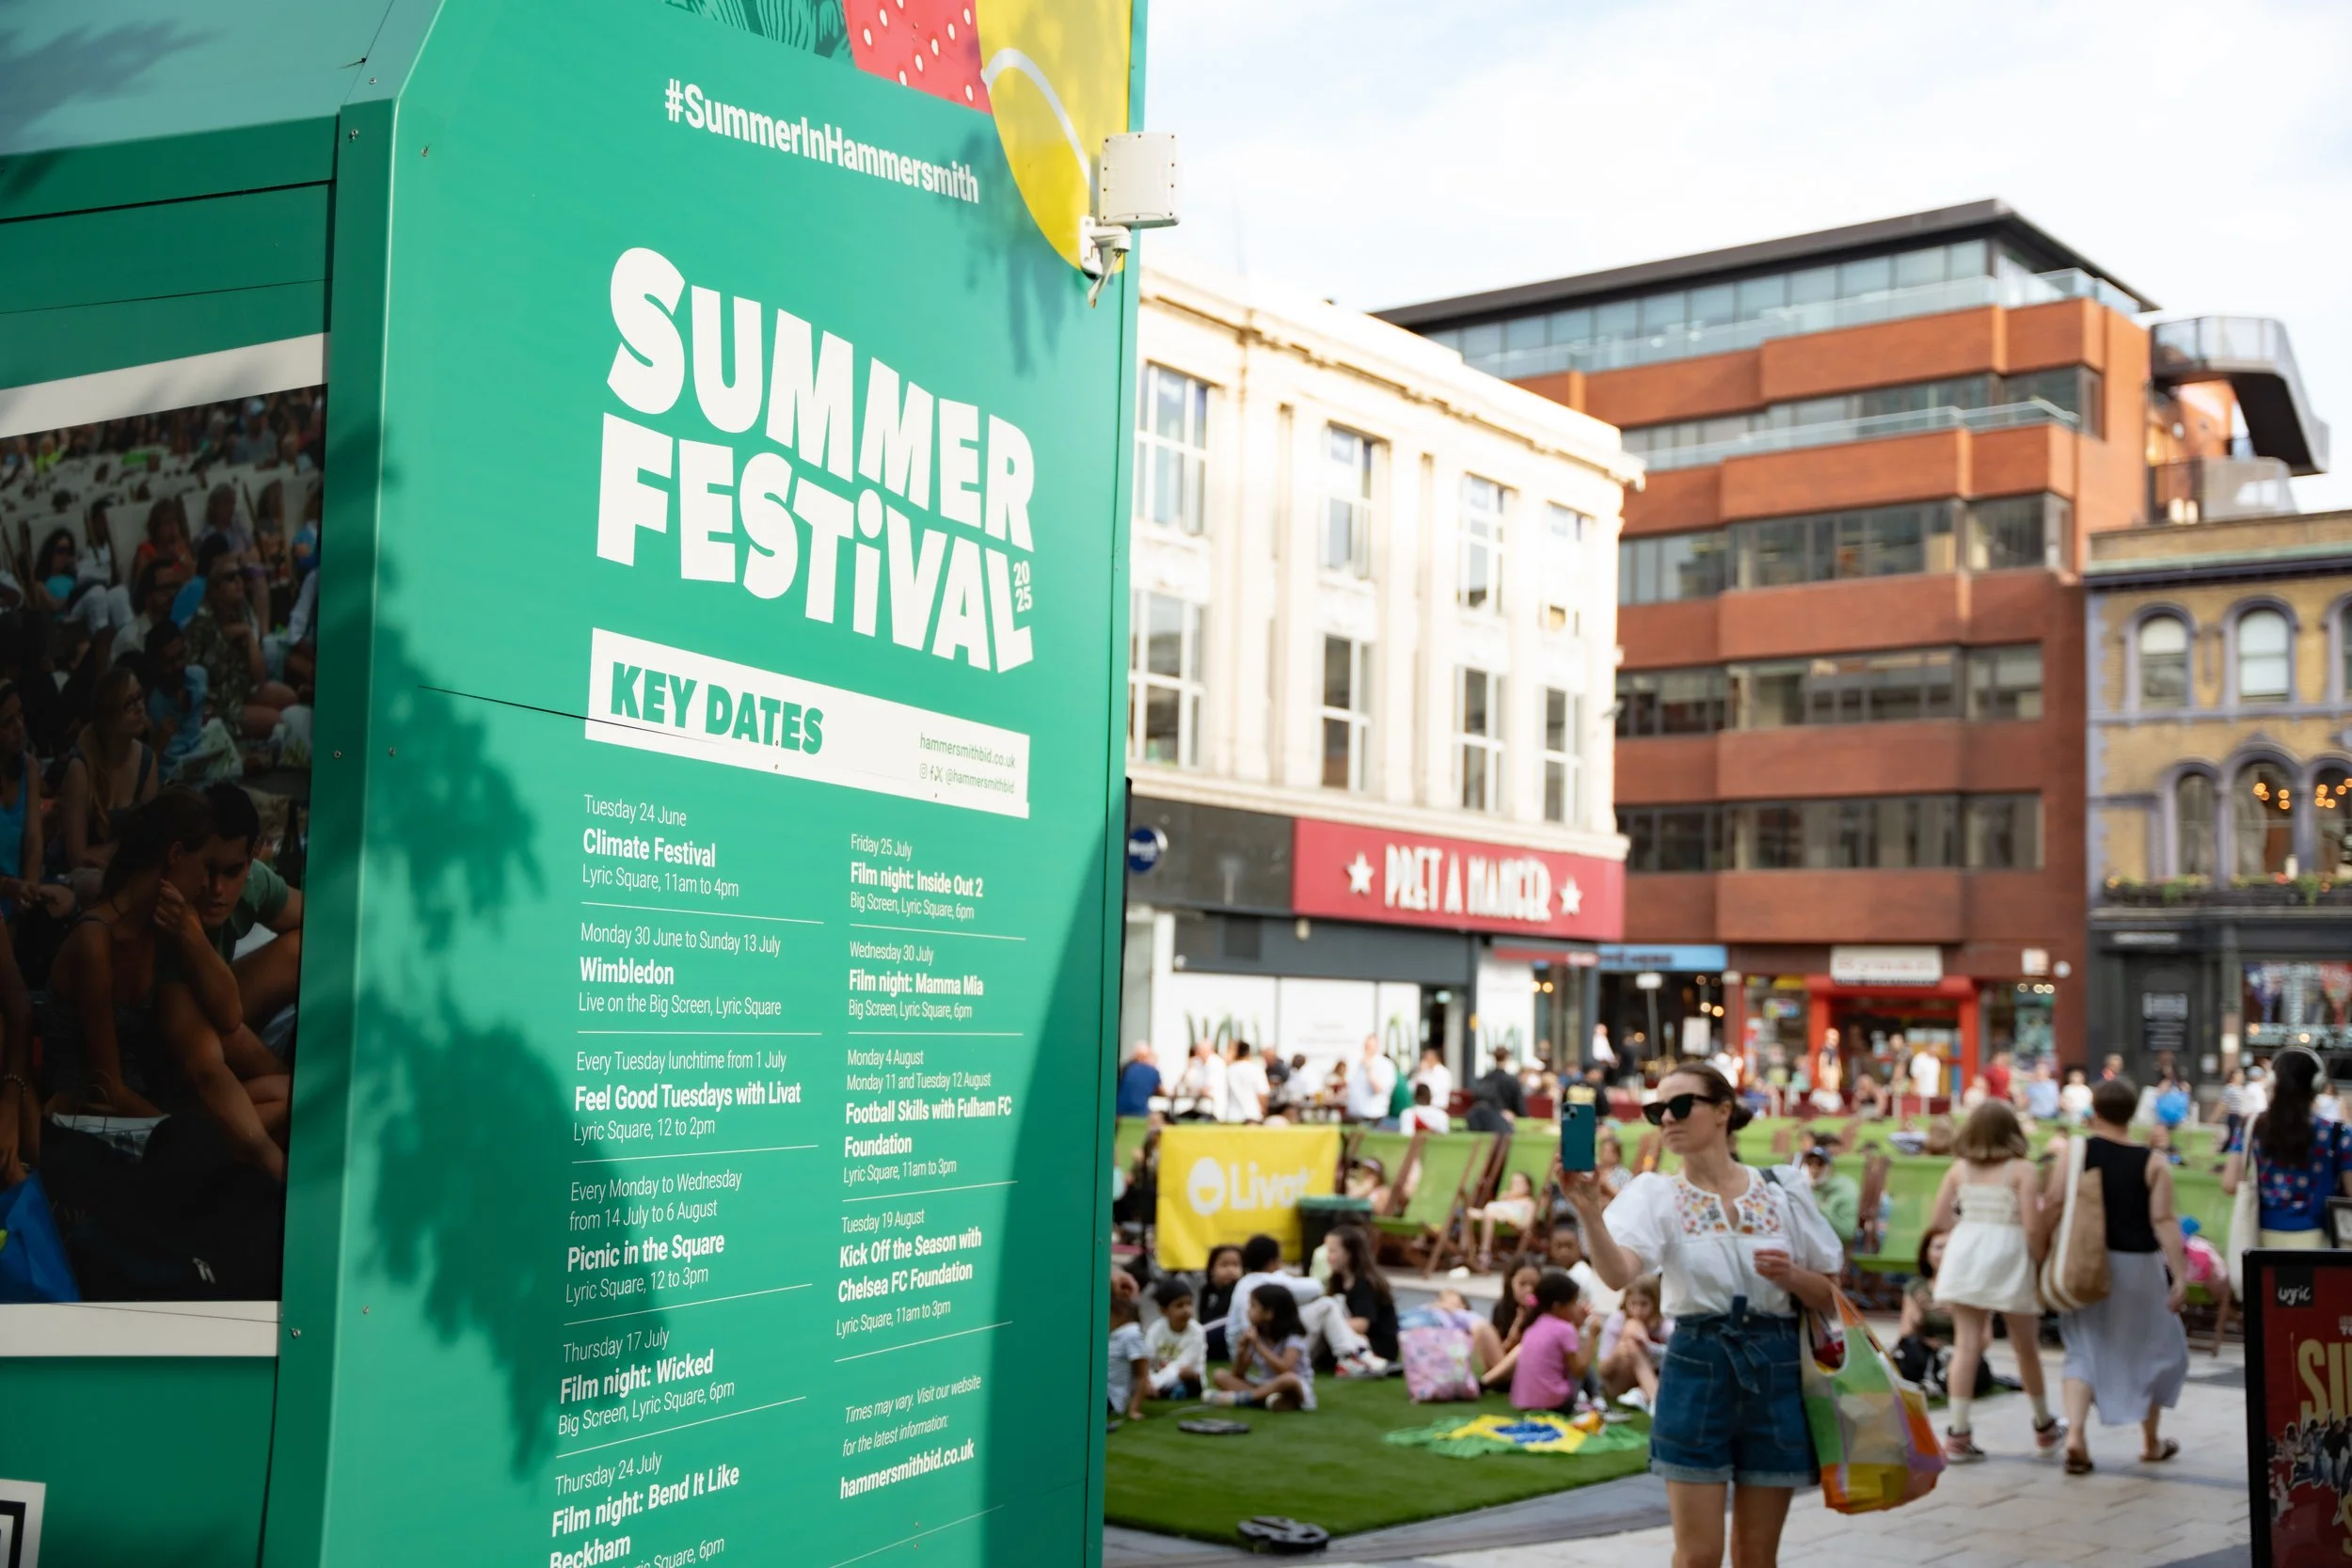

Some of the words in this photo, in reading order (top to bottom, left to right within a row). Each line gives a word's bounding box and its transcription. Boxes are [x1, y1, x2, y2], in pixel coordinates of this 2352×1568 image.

[665, 78, 979, 204] #SummerInHammersmith
[607, 246, 1034, 552] SUMMER
[611, 662, 697, 728] KEY
[706, 682, 823, 755] DATES
[919, 732, 1016, 769] hammersmithbid.co.uk
[584, 794, 637, 824] Tuesday
[640, 802, 655, 822] 24
[658, 806, 687, 827] June
[583, 828, 649, 860] Climate
[654, 836, 715, 867] Festival
[850, 833, 879, 857] Friday
[894, 841, 913, 862] July
[582, 863, 612, 888] Lyric
[615, 866, 661, 893] Square,
[665, 873, 697, 893] 11am
[714, 878, 739, 900] 4pm
[850, 862, 878, 885] Film
[881, 865, 914, 894] night:
[917, 870, 951, 894] Inside
[954, 875, 974, 896] Out
[850, 891, 866, 913] Big
[867, 893, 899, 914] Screen,
[901, 897, 922, 917] Lyric
[923, 898, 954, 920] Square,
[956, 903, 975, 922] 6pm
[581, 922, 632, 949] Monday
[635, 926, 650, 945] 30
[653, 927, 682, 947] June
[699, 930, 740, 956] Sunday
[758, 935, 781, 958] July
[850, 941, 901, 964] Wednesday
[916, 946, 933, 966] July
[580, 957, 674, 985] Wimbledon
[850, 968, 876, 991] Film
[879, 971, 913, 998] night:
[915, 973, 961, 994] Mamma
[963, 975, 983, 996] Mia
[579, 991, 605, 1012] Live
[608, 997, 624, 1012] on
[627, 992, 646, 1012] the
[650, 994, 668, 1018] Big
[672, 994, 713, 1016] Screen,
[716, 996, 741, 1019] Lyric
[744, 997, 781, 1019] Square
[849, 999, 864, 1020] Big
[866, 999, 898, 1019] Screen,
[899, 1001, 920, 1021] Lyric
[921, 1001, 952, 1021] Square,
[954, 1002, 972, 1021] 6pm
[577, 1052, 612, 1075] Every
[614, 1051, 666, 1074] Tuesday
[669, 1051, 724, 1069] lunchtime
[727, 1050, 753, 1069] from
[765, 1050, 787, 1072] July
[848, 1049, 884, 1069] Monday
[893, 1049, 924, 1069] August
[575, 1084, 611, 1111] Feel
[615, 1083, 658, 1110] Good
[660, 1082, 732, 1113] Tuesdays
[736, 1081, 765, 1105] with
[769, 1081, 802, 1104] Livat
[847, 1073, 883, 1094] Monday
[898, 1072, 914, 1089] and
[915, 1072, 950, 1092] Tuesday
[963, 1072, 992, 1091] August
[846, 1100, 896, 1124] Football
[898, 1099, 929, 1121] Skills
[931, 1098, 955, 1119] with
[958, 1096, 995, 1118] Fulham
[997, 1096, 1012, 1116] FC
[574, 1121, 604, 1146] Lyric
[608, 1120, 654, 1144] Square,
[658, 1117, 672, 1136] 12
[690, 1117, 715, 1139] 2pm
[845, 1132, 912, 1158] Foundation
[571, 1181, 606, 1204] Every
[610, 1176, 660, 1199] Monday
[676, 1169, 742, 1192] Wednesday
[843, 1165, 866, 1187] Lyric
[867, 1164, 900, 1184] Square,
[902, 1161, 927, 1177] 11am
[938, 1158, 957, 1177] 3pm
[569, 1211, 600, 1231] from
[605, 1208, 620, 1227] 14
[623, 1205, 649, 1229] July
[676, 1199, 718, 1223] August
[841, 1213, 880, 1234] Tuesday
[894, 1209, 925, 1229] August
[567, 1242, 620, 1272] Picnic
[624, 1240, 639, 1265] in
[643, 1237, 668, 1262] the
[672, 1234, 724, 1263] Square
[840, 1243, 868, 1268] Kick
[870, 1238, 891, 1263] Off
[893, 1237, 913, 1259] the
[914, 1235, 956, 1257] Season
[959, 1226, 981, 1249] with
[566, 1281, 596, 1307] Lyric
[600, 1277, 646, 1300] Square,
[651, 1270, 665, 1290] 12
[682, 1267, 708, 1289] 3pm
[838, 1275, 888, 1303] Chelsea
[891, 1270, 908, 1293] FC
[910, 1260, 973, 1290] Foundation
[836, 1317, 859, 1339] Lyric
[860, 1313, 894, 1332] Square,
[896, 1307, 920, 1323] 11am
[931, 1300, 951, 1319] 3pm
[563, 1337, 623, 1363] Thursday
[627, 1331, 642, 1351] 17
[644, 1326, 670, 1351] July
[561, 1374, 598, 1404] Film
[603, 1364, 651, 1398] night:
[656, 1348, 714, 1384] Wicked
[559, 1414, 580, 1437] Big
[582, 1406, 628, 1430] Screen,
[632, 1395, 660, 1421] Lyric
[663, 1388, 707, 1413] Square,
[709, 1382, 735, 1403] 6pm
[846, 1405, 873, 1423] Times
[874, 1400, 894, 1417] may
[917, 1386, 935, 1404] Visit
[951, 1375, 981, 1395] website
[843, 1438, 856, 1457] for
[858, 1434, 872, 1452] the
[873, 1427, 898, 1448] latest
[554, 1465, 616, 1496] Thursday
[618, 1458, 634, 1480] 24
[636, 1451, 662, 1475] July
[840, 1438, 974, 1499] hammersmithbid.co.uk
[552, 1505, 591, 1537] Film
[596, 1491, 644, 1527] night:
[648, 1474, 690, 1510] Bend
[692, 1472, 705, 1497] It
[707, 1464, 739, 1492] Like
[549, 1535, 630, 1568] Beckham
[699, 1538, 724, 1561] 6pm
